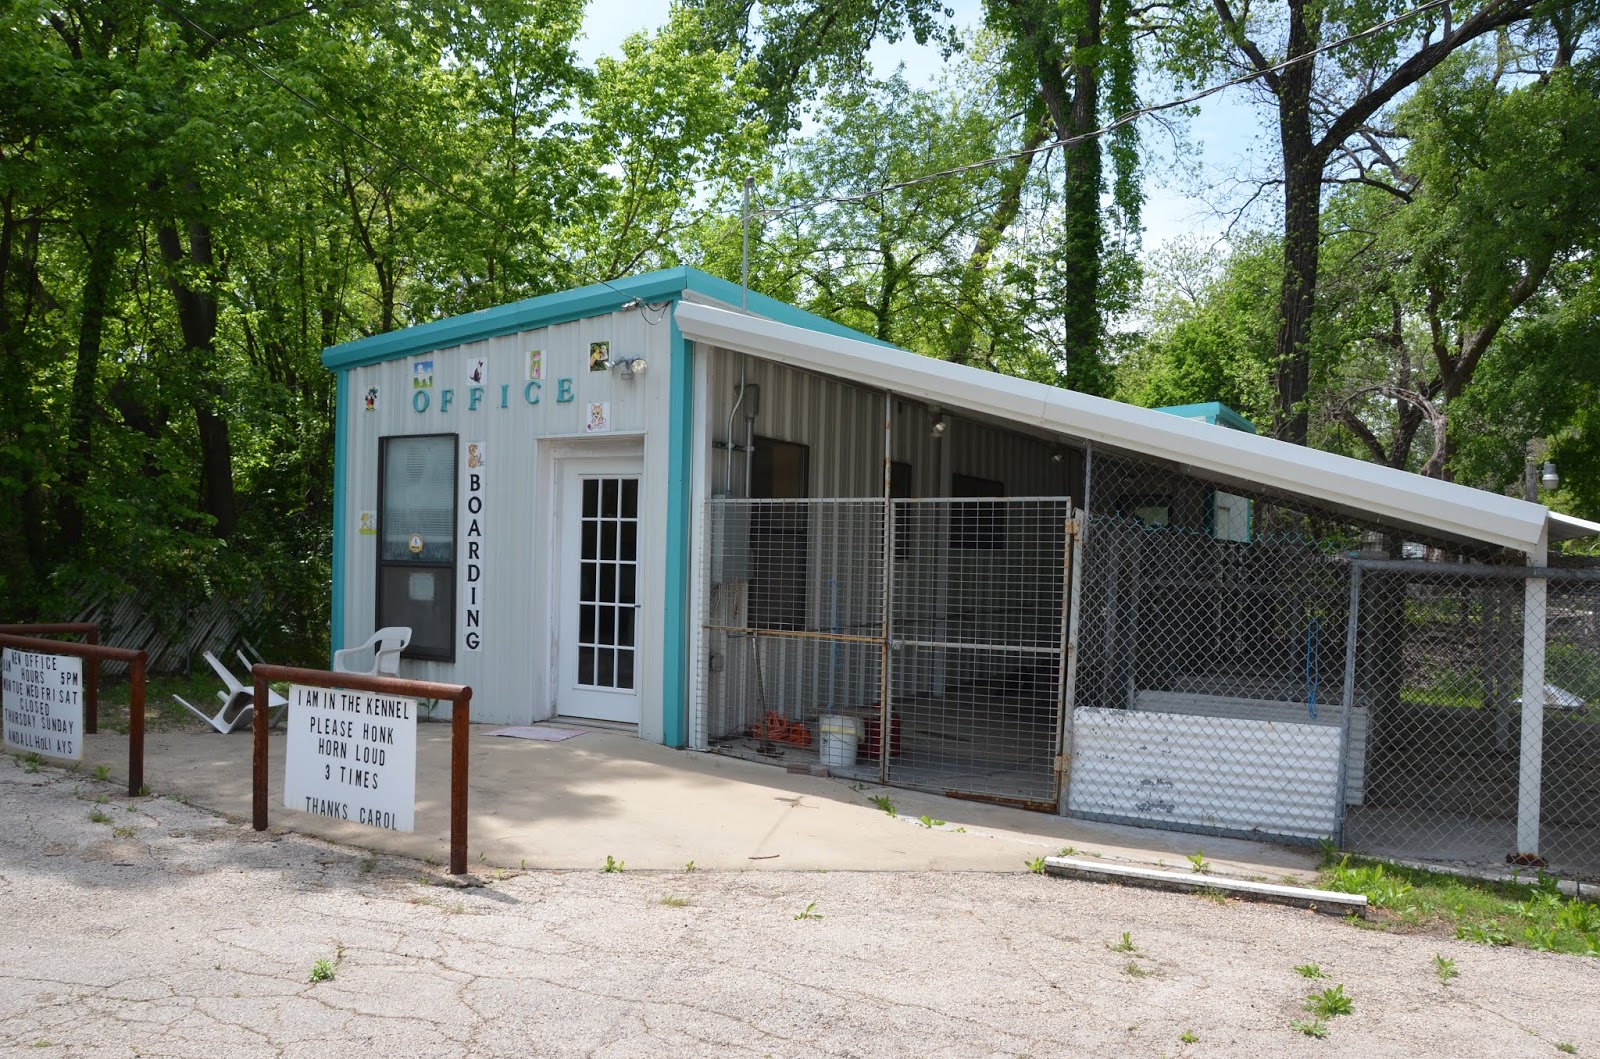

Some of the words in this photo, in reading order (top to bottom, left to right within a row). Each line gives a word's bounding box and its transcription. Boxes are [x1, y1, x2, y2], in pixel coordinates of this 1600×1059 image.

[412, 376, 575, 413] OFFICE
[466, 474, 482, 650] BOARDING
[21, 667, 44, 684] HOURS
[60, 671, 78, 686] 5PM
[25, 654, 57, 671] OFFICE
[12, 680, 23, 695] TUE
[26, 684, 39, 699] WED
[42, 687, 56, 702] FRI
[59, 689, 78, 705] SAT
[298, 689, 302, 706] I
[306, 690, 319, 707] AM
[324, 692, 336, 710] IN
[341, 694, 361, 714] THE
[366, 697, 409, 720] KENNEL
[20, 698, 50, 716] CLOSED
[5, 708, 36, 728] THURSDAY
[41, 716, 74, 735] SUNDAY
[310, 716, 353, 738] PLEASE
[363, 722, 394, 745] HONK
[318, 737, 347, 760] HORN
[355, 744, 386, 766] LOUD
[325, 764, 331, 780] 3
[340, 766, 378, 789] TIMES
[305, 796, 348, 820] THANKS
[359, 807, 397, 831] CAROL
